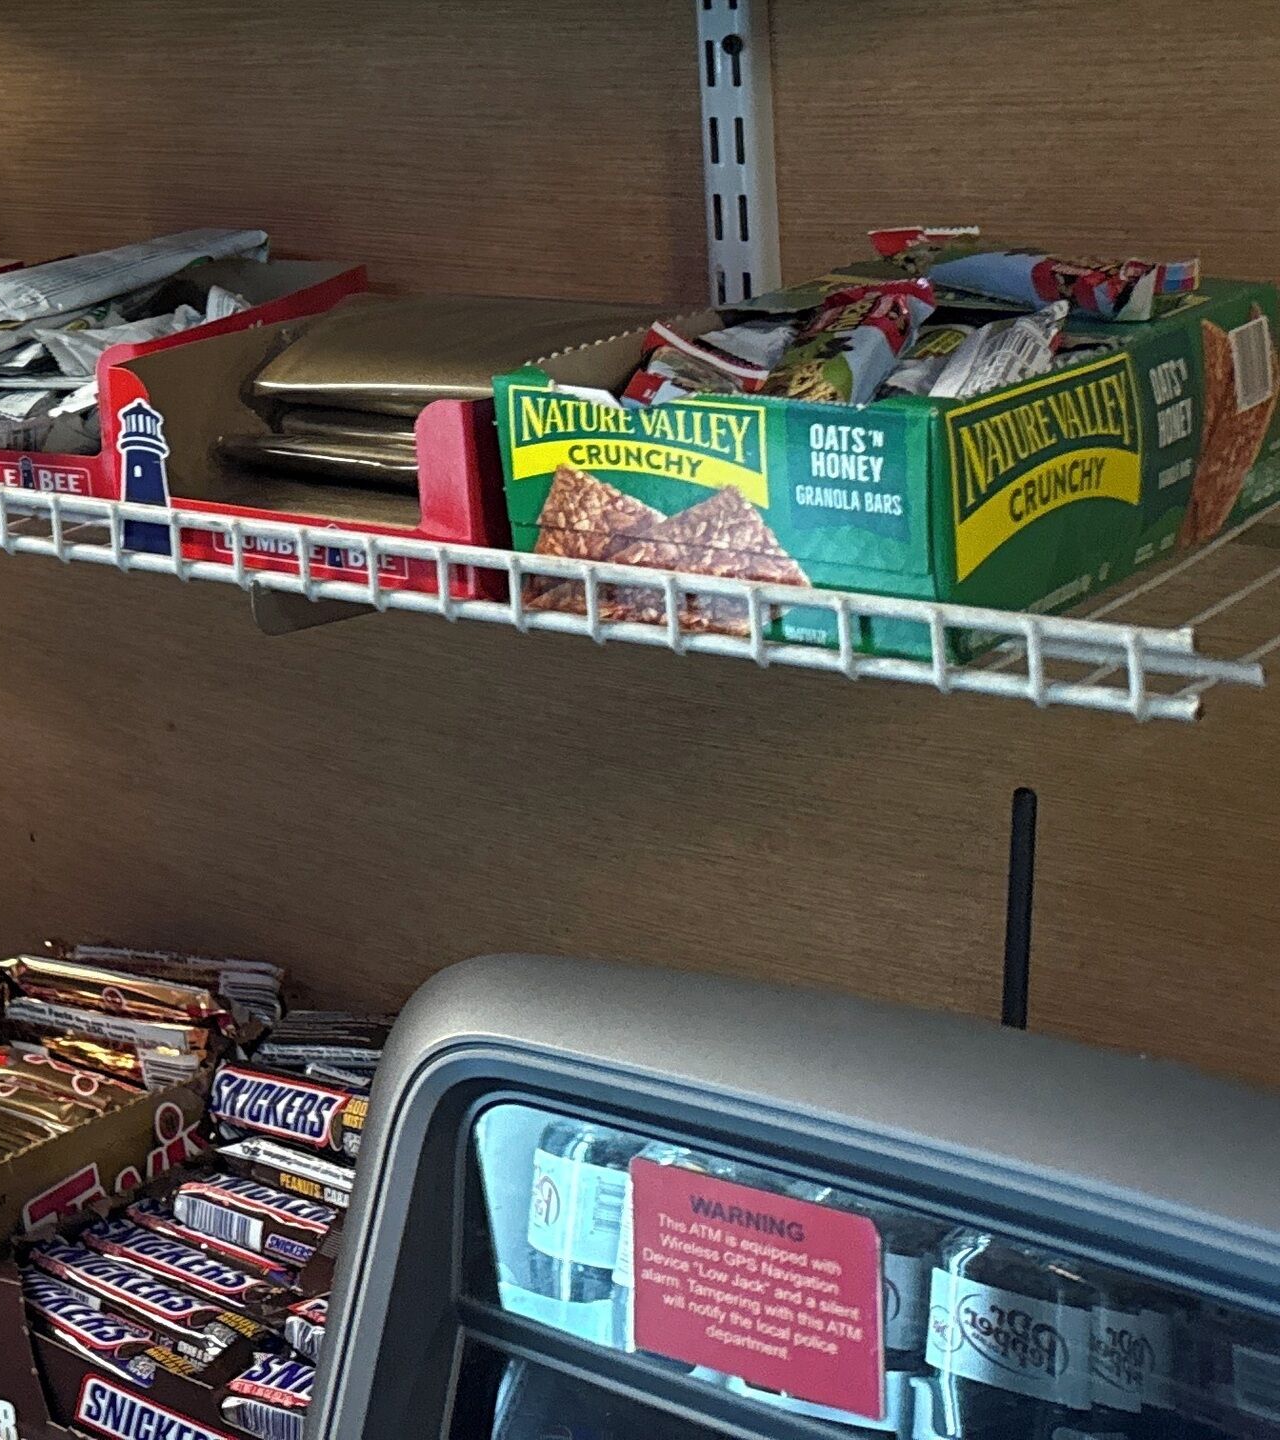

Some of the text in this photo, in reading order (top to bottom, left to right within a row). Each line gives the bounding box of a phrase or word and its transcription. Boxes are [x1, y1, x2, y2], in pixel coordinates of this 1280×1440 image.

[521, 394, 752, 464] NATURE VALLEY
[809, 423, 865, 453] OATS
[959, 370, 1132, 508] NATURE VALLEY
[38, 468, 83, 494] BEE
[567, 443, 704, 479] CRUNCHY
[810, 452, 885, 483] HONEY
[1007, 455, 1108, 523] CRUNCHY
[795, 483, 903, 517] GRANOLA BARS
[210, 1072, 333, 1141] SNICKERS
[264, 1233, 317, 1260] SNICKERS
[657, 1212, 842, 1277] This ATM is equipped with
[690, 1193, 806, 1242] WARNING
[642, 1247, 690, 1273] Device
[774, 1287, 803, 1306] and
[806, 1296, 817, 1309] a
[819, 1299, 861, 1321] silent
[659, 1233, 840, 1296] Wireless GPS Navigation
[662, 1293, 839, 1355] will notify the local police
[687, 1276, 762, 1315] Tampering
[764, 1303, 795, 1322] with
[797, 1311, 825, 1331] this
[826, 1320, 864, 1343] ATM
